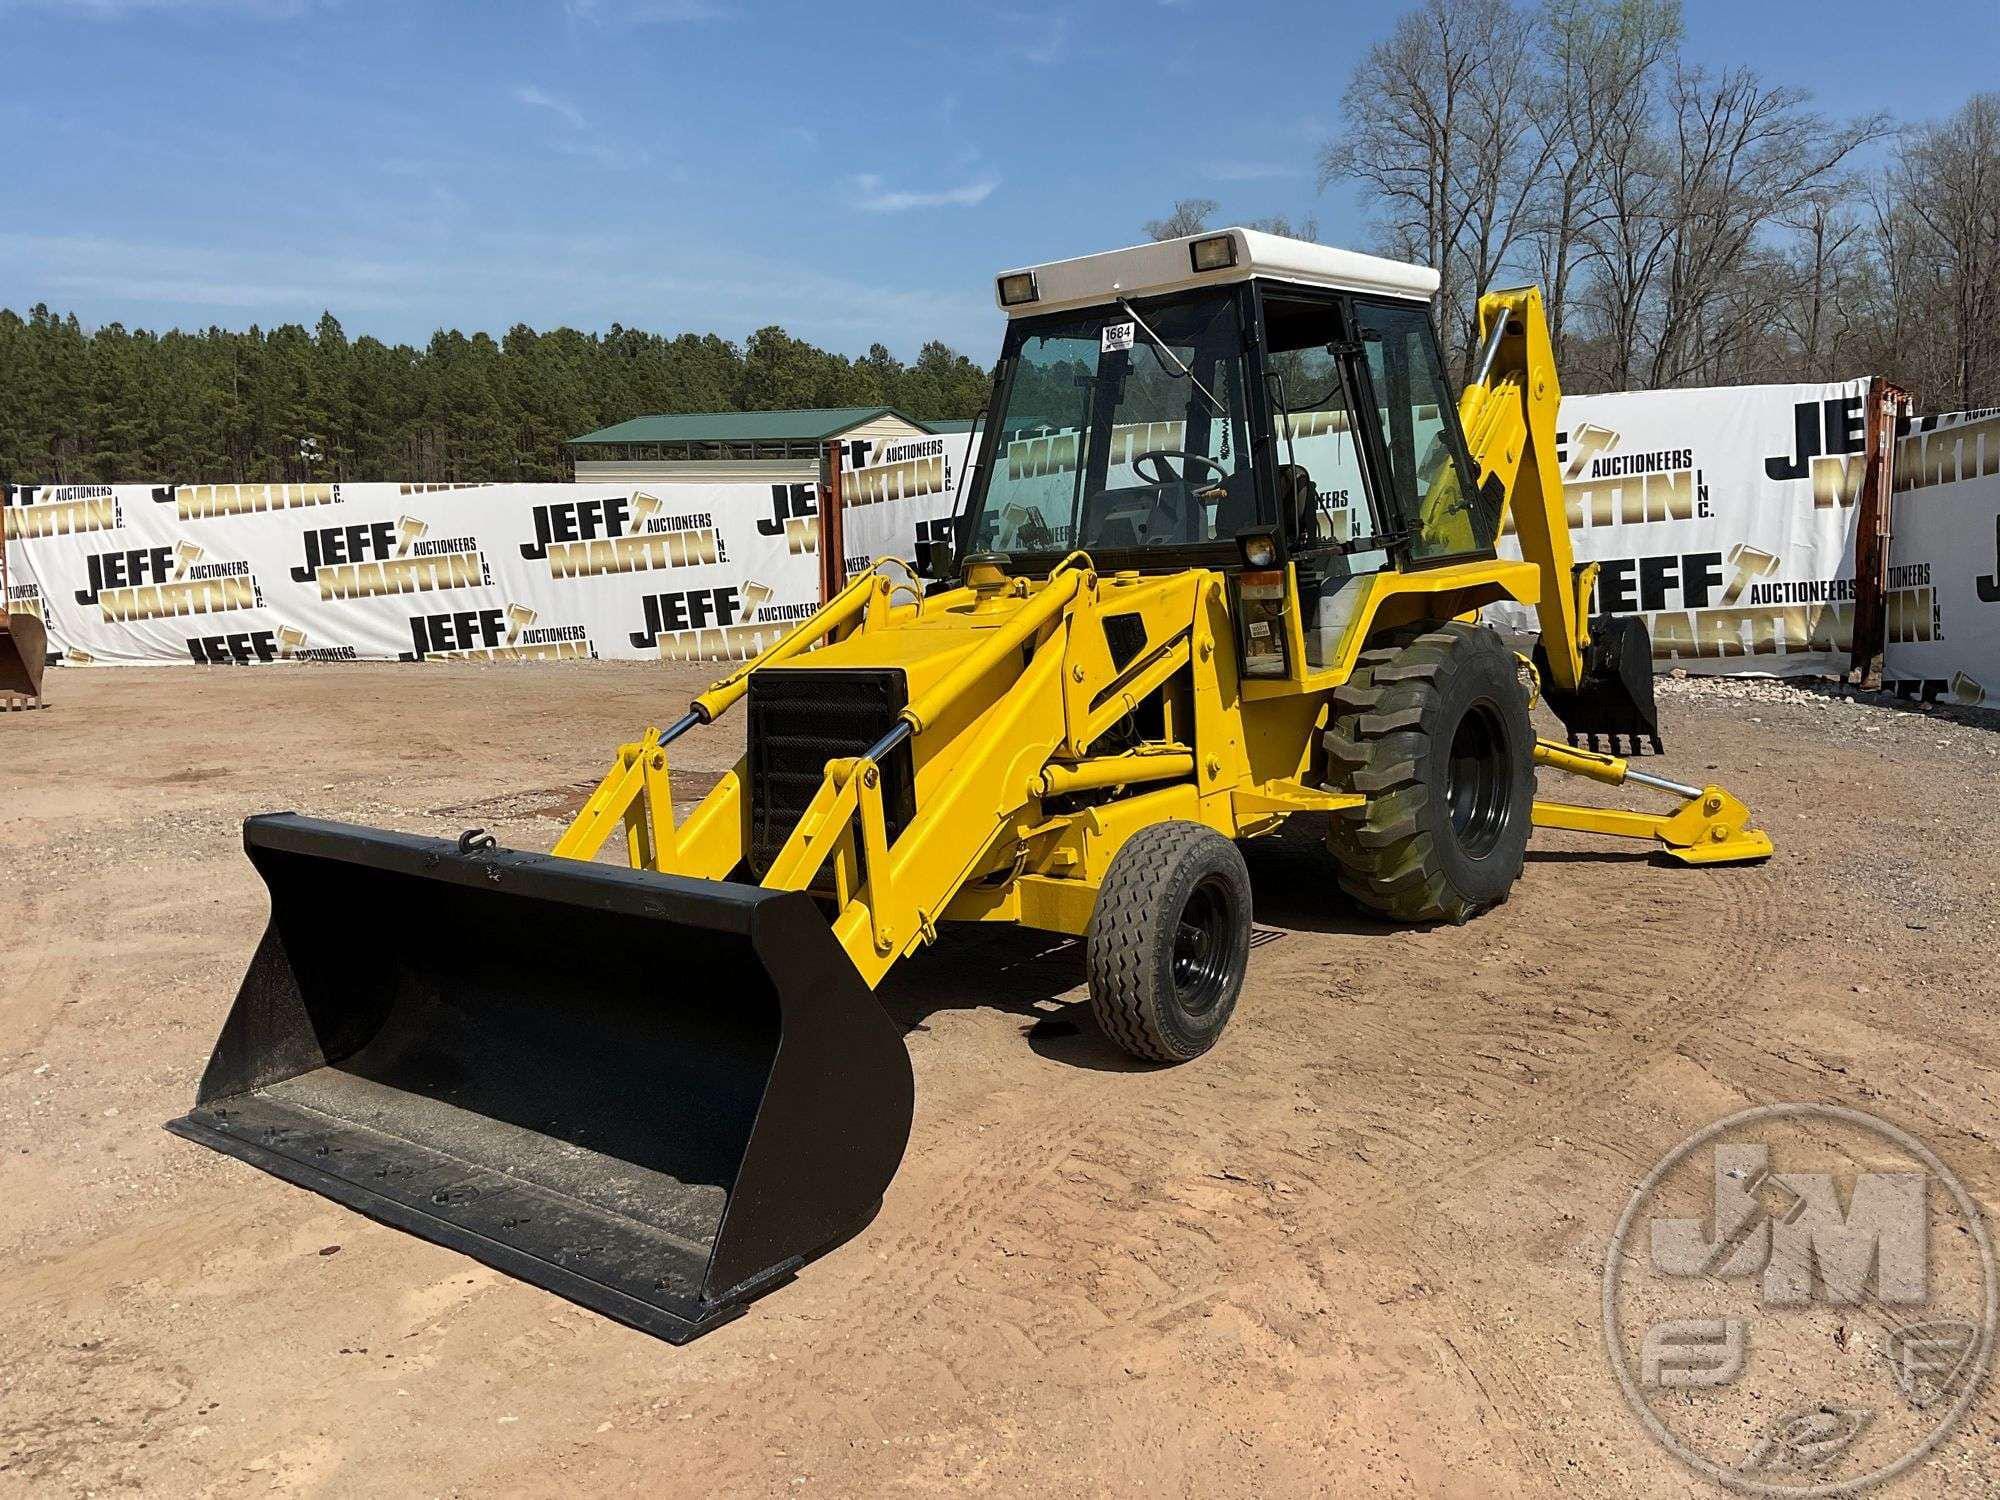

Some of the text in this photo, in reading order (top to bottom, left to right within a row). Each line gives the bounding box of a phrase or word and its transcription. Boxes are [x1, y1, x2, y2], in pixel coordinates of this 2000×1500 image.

[1105, 325, 1130, 341] 1684
[886, 440, 943, 463] AUCTIONEERS
[1765, 396, 1865, 480] JE
[1592, 449, 1692, 478] AUCTIONEERS
[757, 483, 817, 536] JE
[1697, 469, 1715, 518] INC.
[520, 498, 630, 560] JEFF
[647, 513, 712, 534] AUCTIONEERS
[290, 521, 397, 583] JEFF
[413, 537, 476, 556] AUCTIONEERS
[550, 529, 716, 580] MARTIN
[716, 527, 731, 563] INC.
[75, 547, 174, 605] JEFF
[190, 561, 249, 580] AUCTIONEERS
[317, 552, 482, 601] MARTIN
[480, 551, 495, 586] INC.
[1888, 563, 1930, 588] TIONEERS
[100, 576, 253, 624] MARTIN
[252, 574, 267, 608] INC.
[1751, 579, 1856, 604] AUCTIONEERS
[399, 609, 506, 662] JEFF
[523, 626, 586, 644] AUCTIONEERS
[629, 586, 740, 648] JEFF
[1652, 602, 1855, 659] ARTIN
